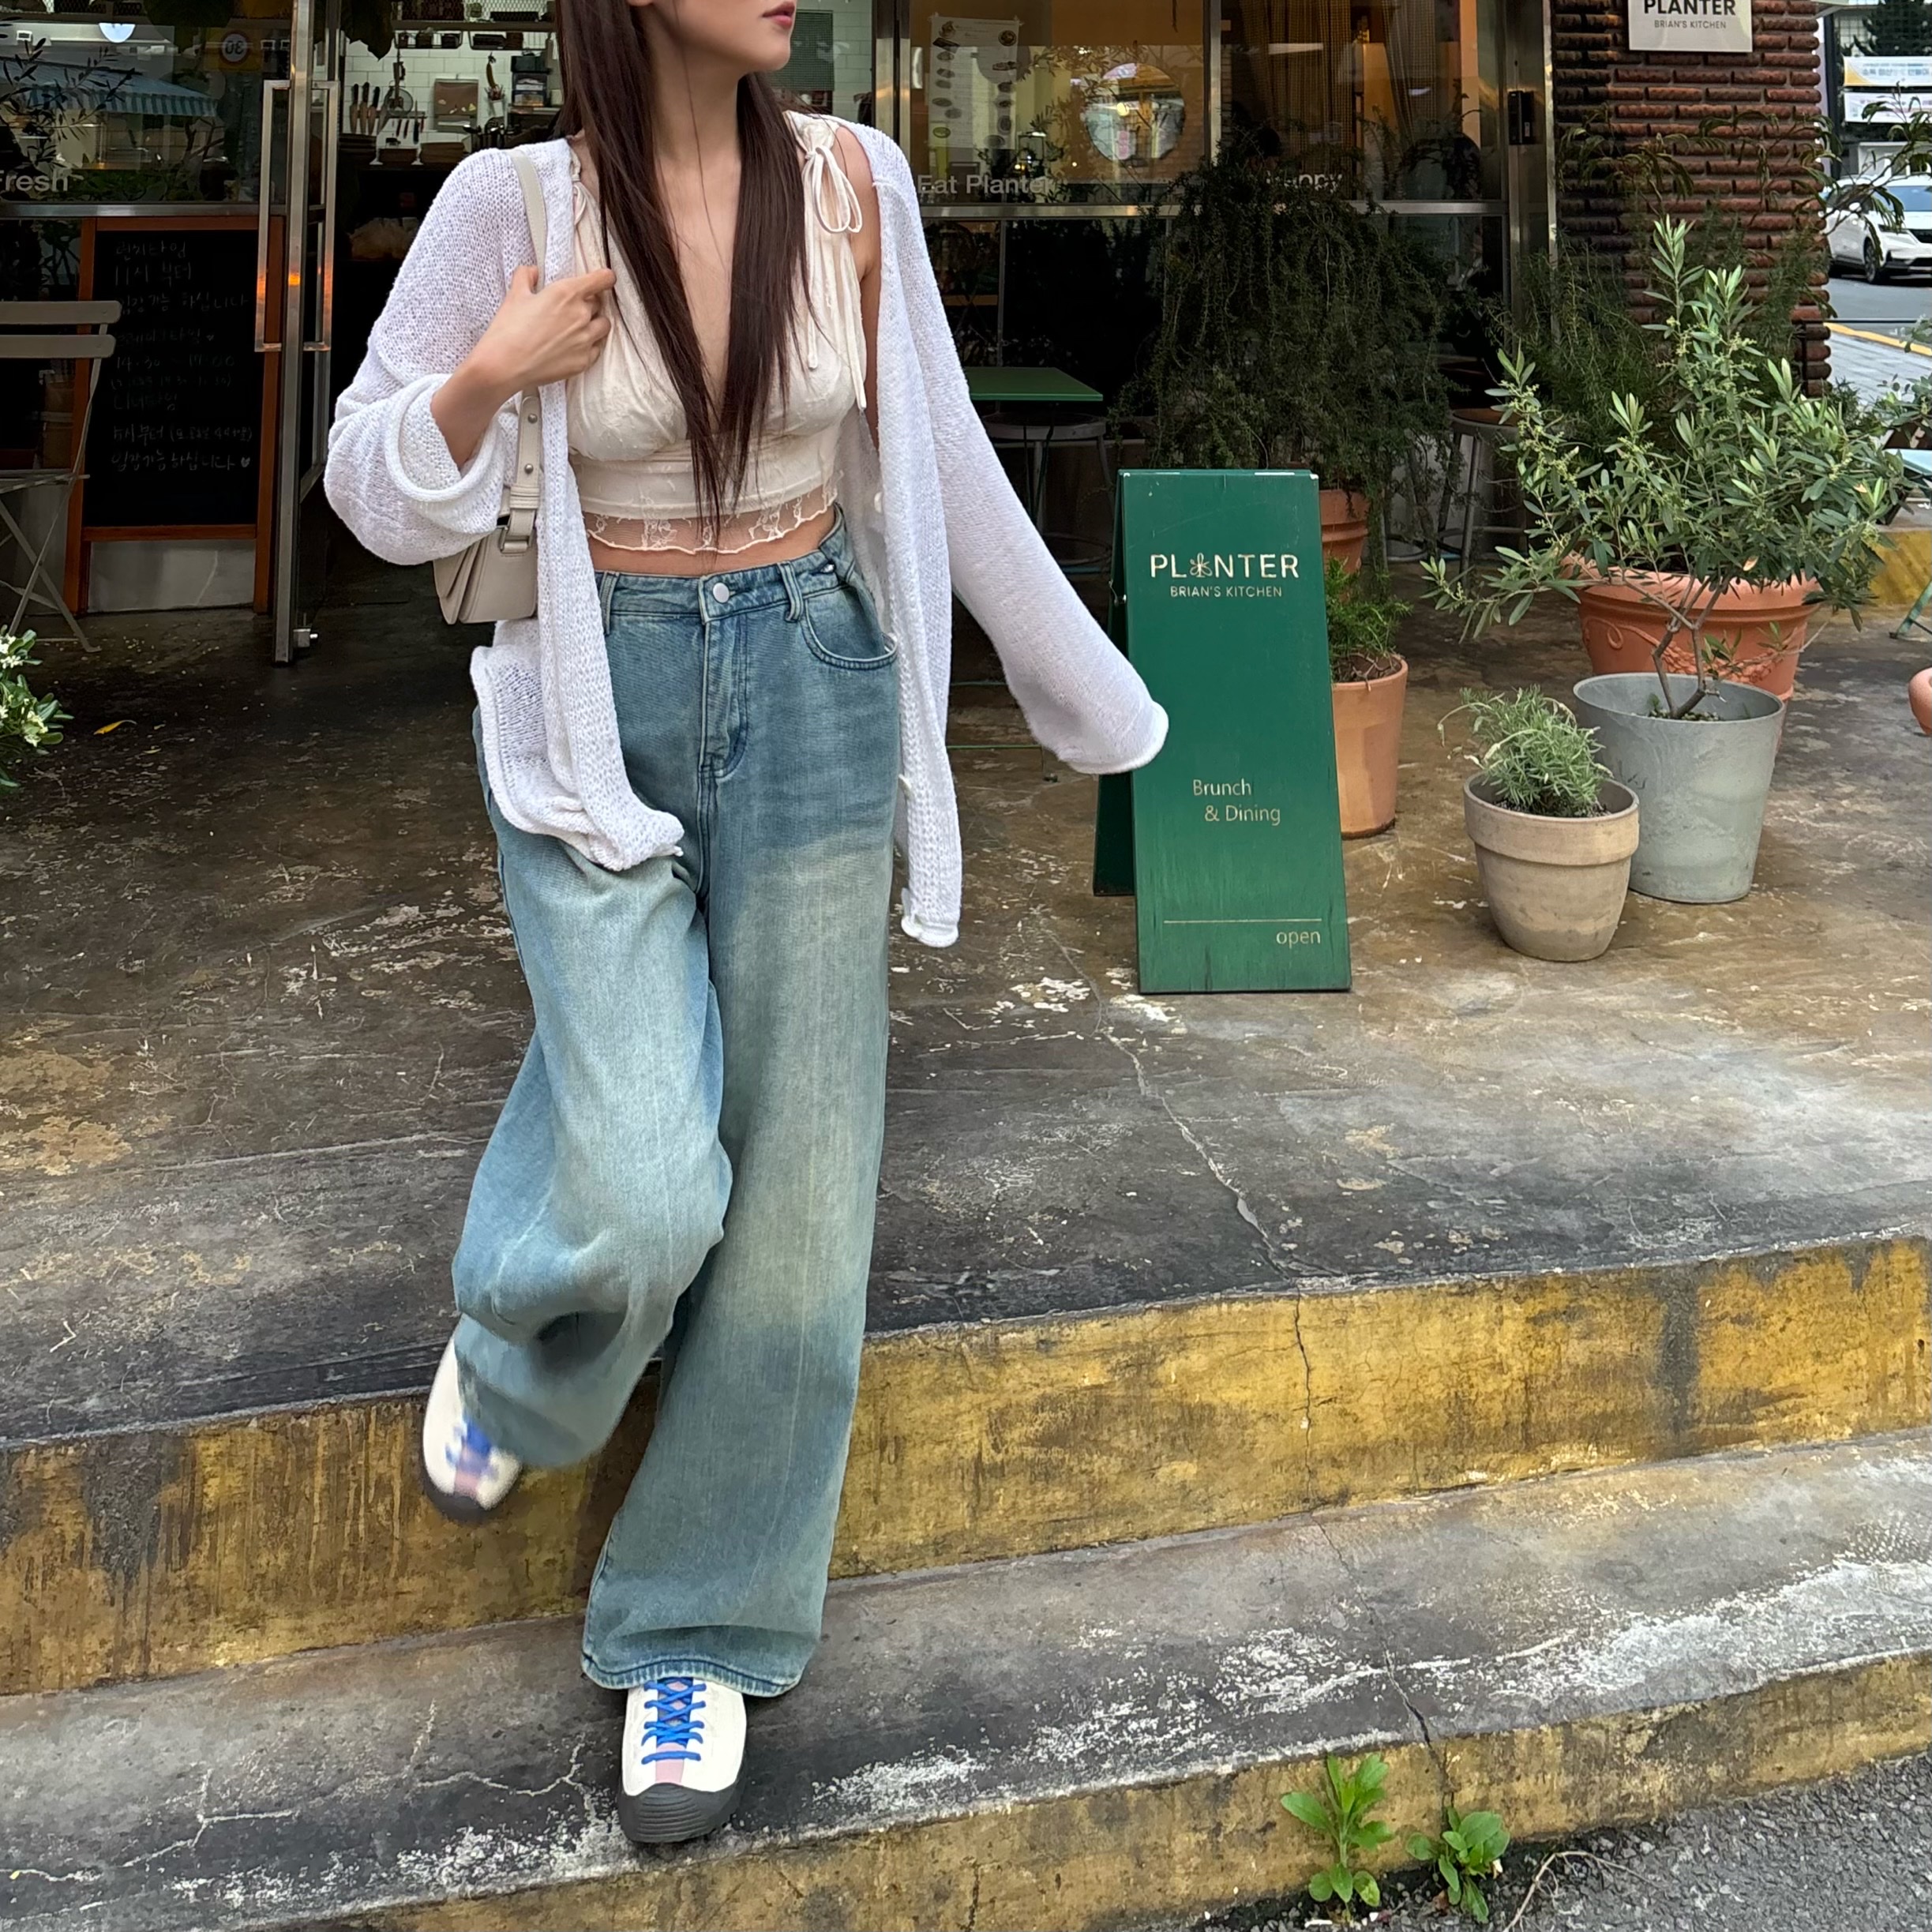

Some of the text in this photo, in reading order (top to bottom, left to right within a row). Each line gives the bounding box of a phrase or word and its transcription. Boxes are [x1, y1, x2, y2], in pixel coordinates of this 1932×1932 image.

[1644, 0, 1736, 15] PLANTER
[0, 168, 68, 191] resh
[917, 174, 958, 194] Eat
[1170, 586, 1282, 598] BRIAN'S KITCHEN
[1192, 778, 1252, 796] Brunch
[1204, 804, 1281, 826] & Dining
[1276, 931, 1321, 949] open
